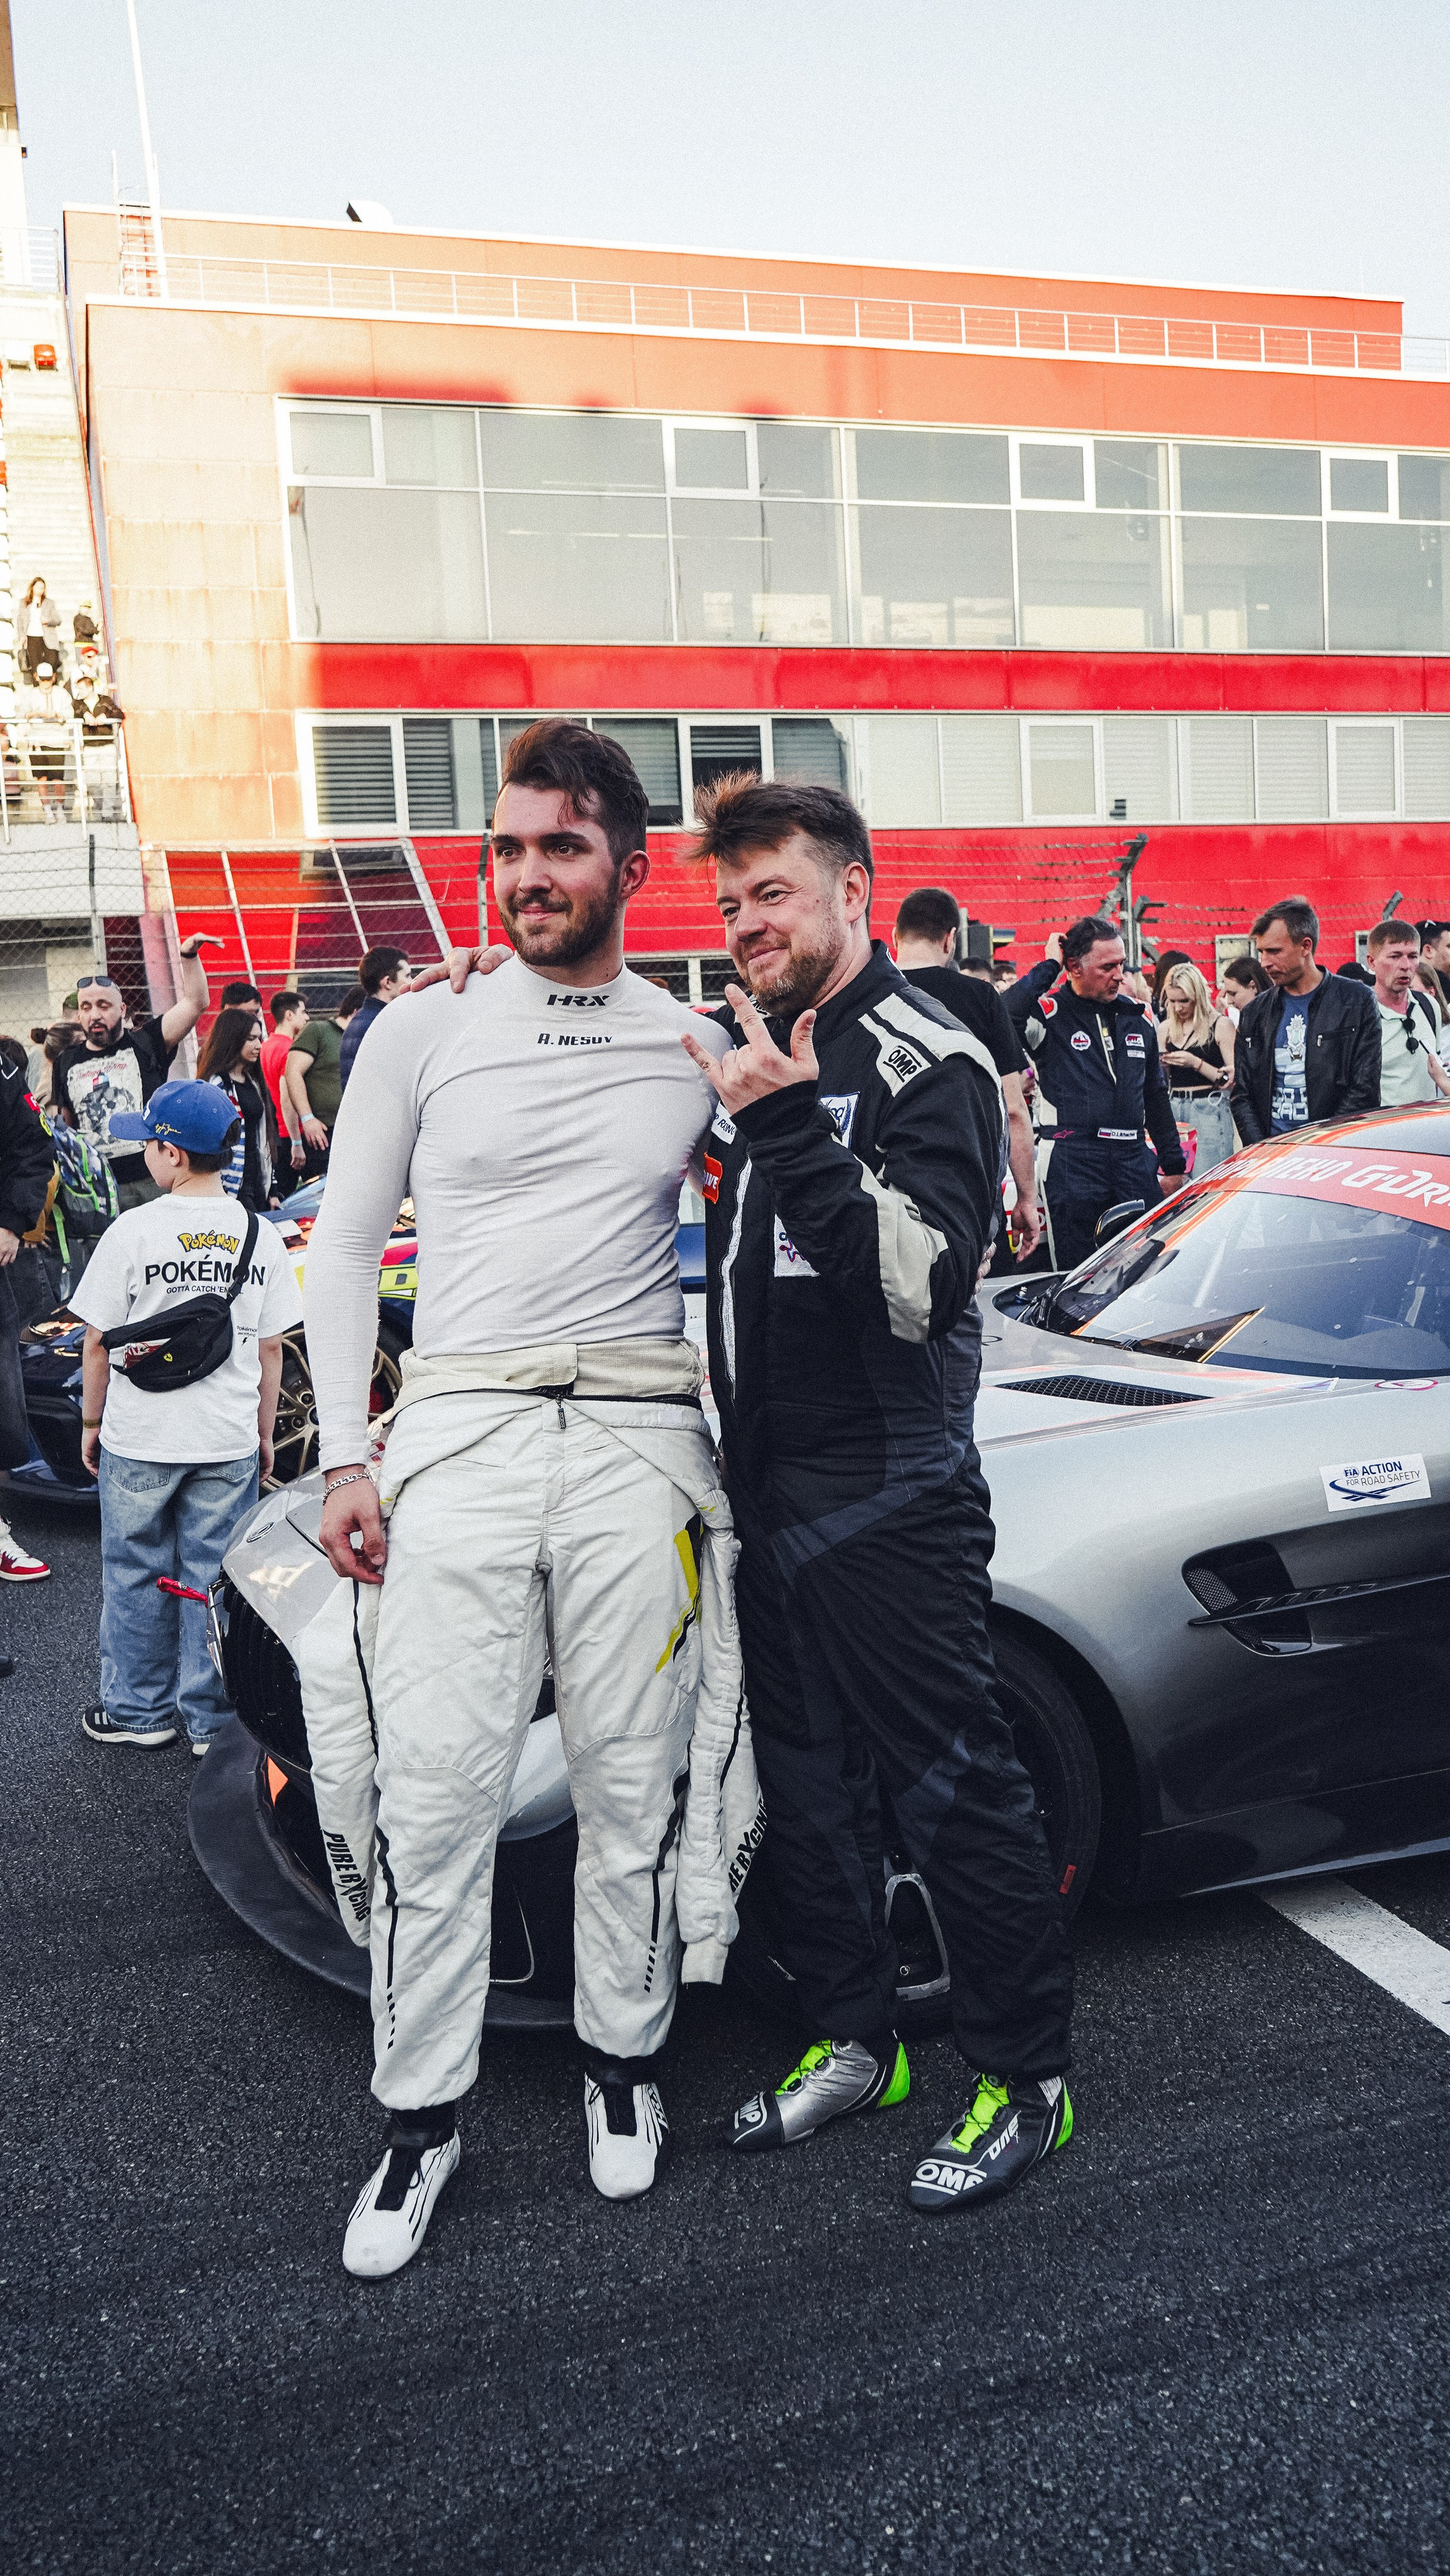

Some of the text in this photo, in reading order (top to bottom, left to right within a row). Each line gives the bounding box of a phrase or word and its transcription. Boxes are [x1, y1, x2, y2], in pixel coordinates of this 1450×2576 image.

[547, 994, 610, 1006] HRX
[888, 1049, 918, 1077] OMP
[167, 1285, 189, 1294] GOTTA
[1362, 1461, 1403, 1476] ACTION
[1361, 1475, 1386, 1486] ROAD
[1388, 1470, 1420, 1483] SAFETY
[323, 1829, 358, 1872] PURE
